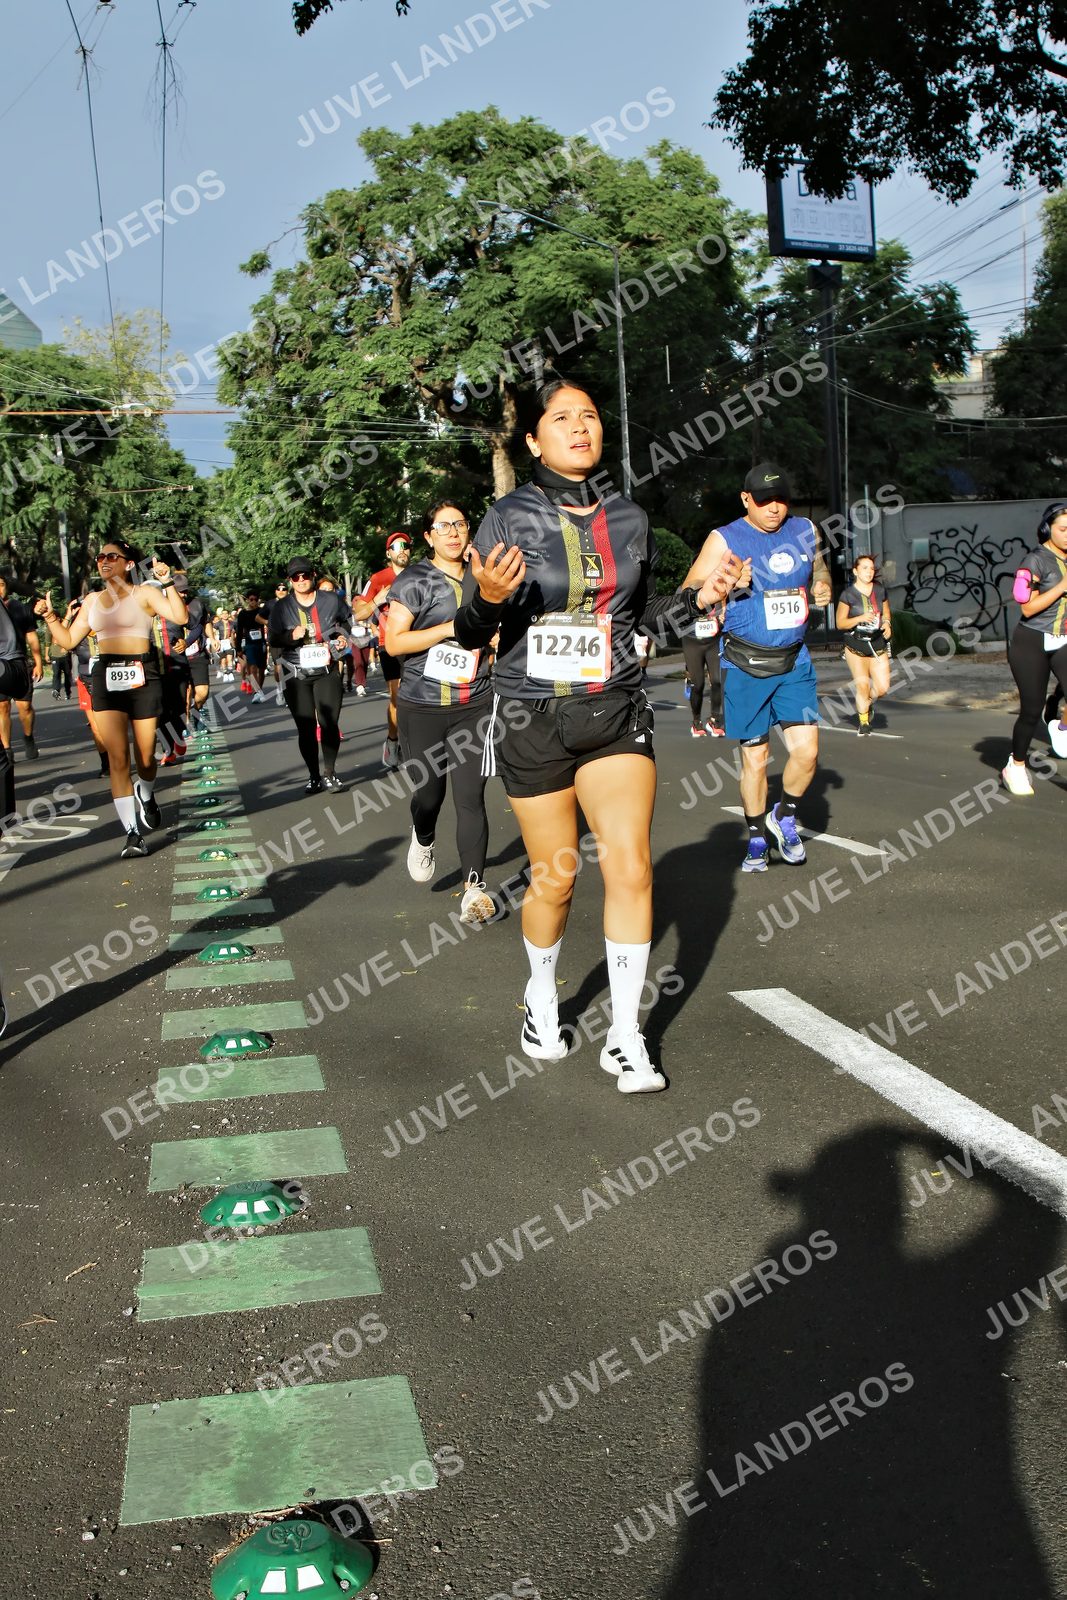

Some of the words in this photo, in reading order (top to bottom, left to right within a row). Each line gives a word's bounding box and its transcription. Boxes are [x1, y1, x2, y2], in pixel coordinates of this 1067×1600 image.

[929, 524, 978, 543] TOY
[771, 601, 800, 615] 9516
[699, 623, 714, 631] 9901
[532, 634, 600, 657] 12246
[435, 650, 467, 669] 9653
[111, 670, 136, 681] 8939
